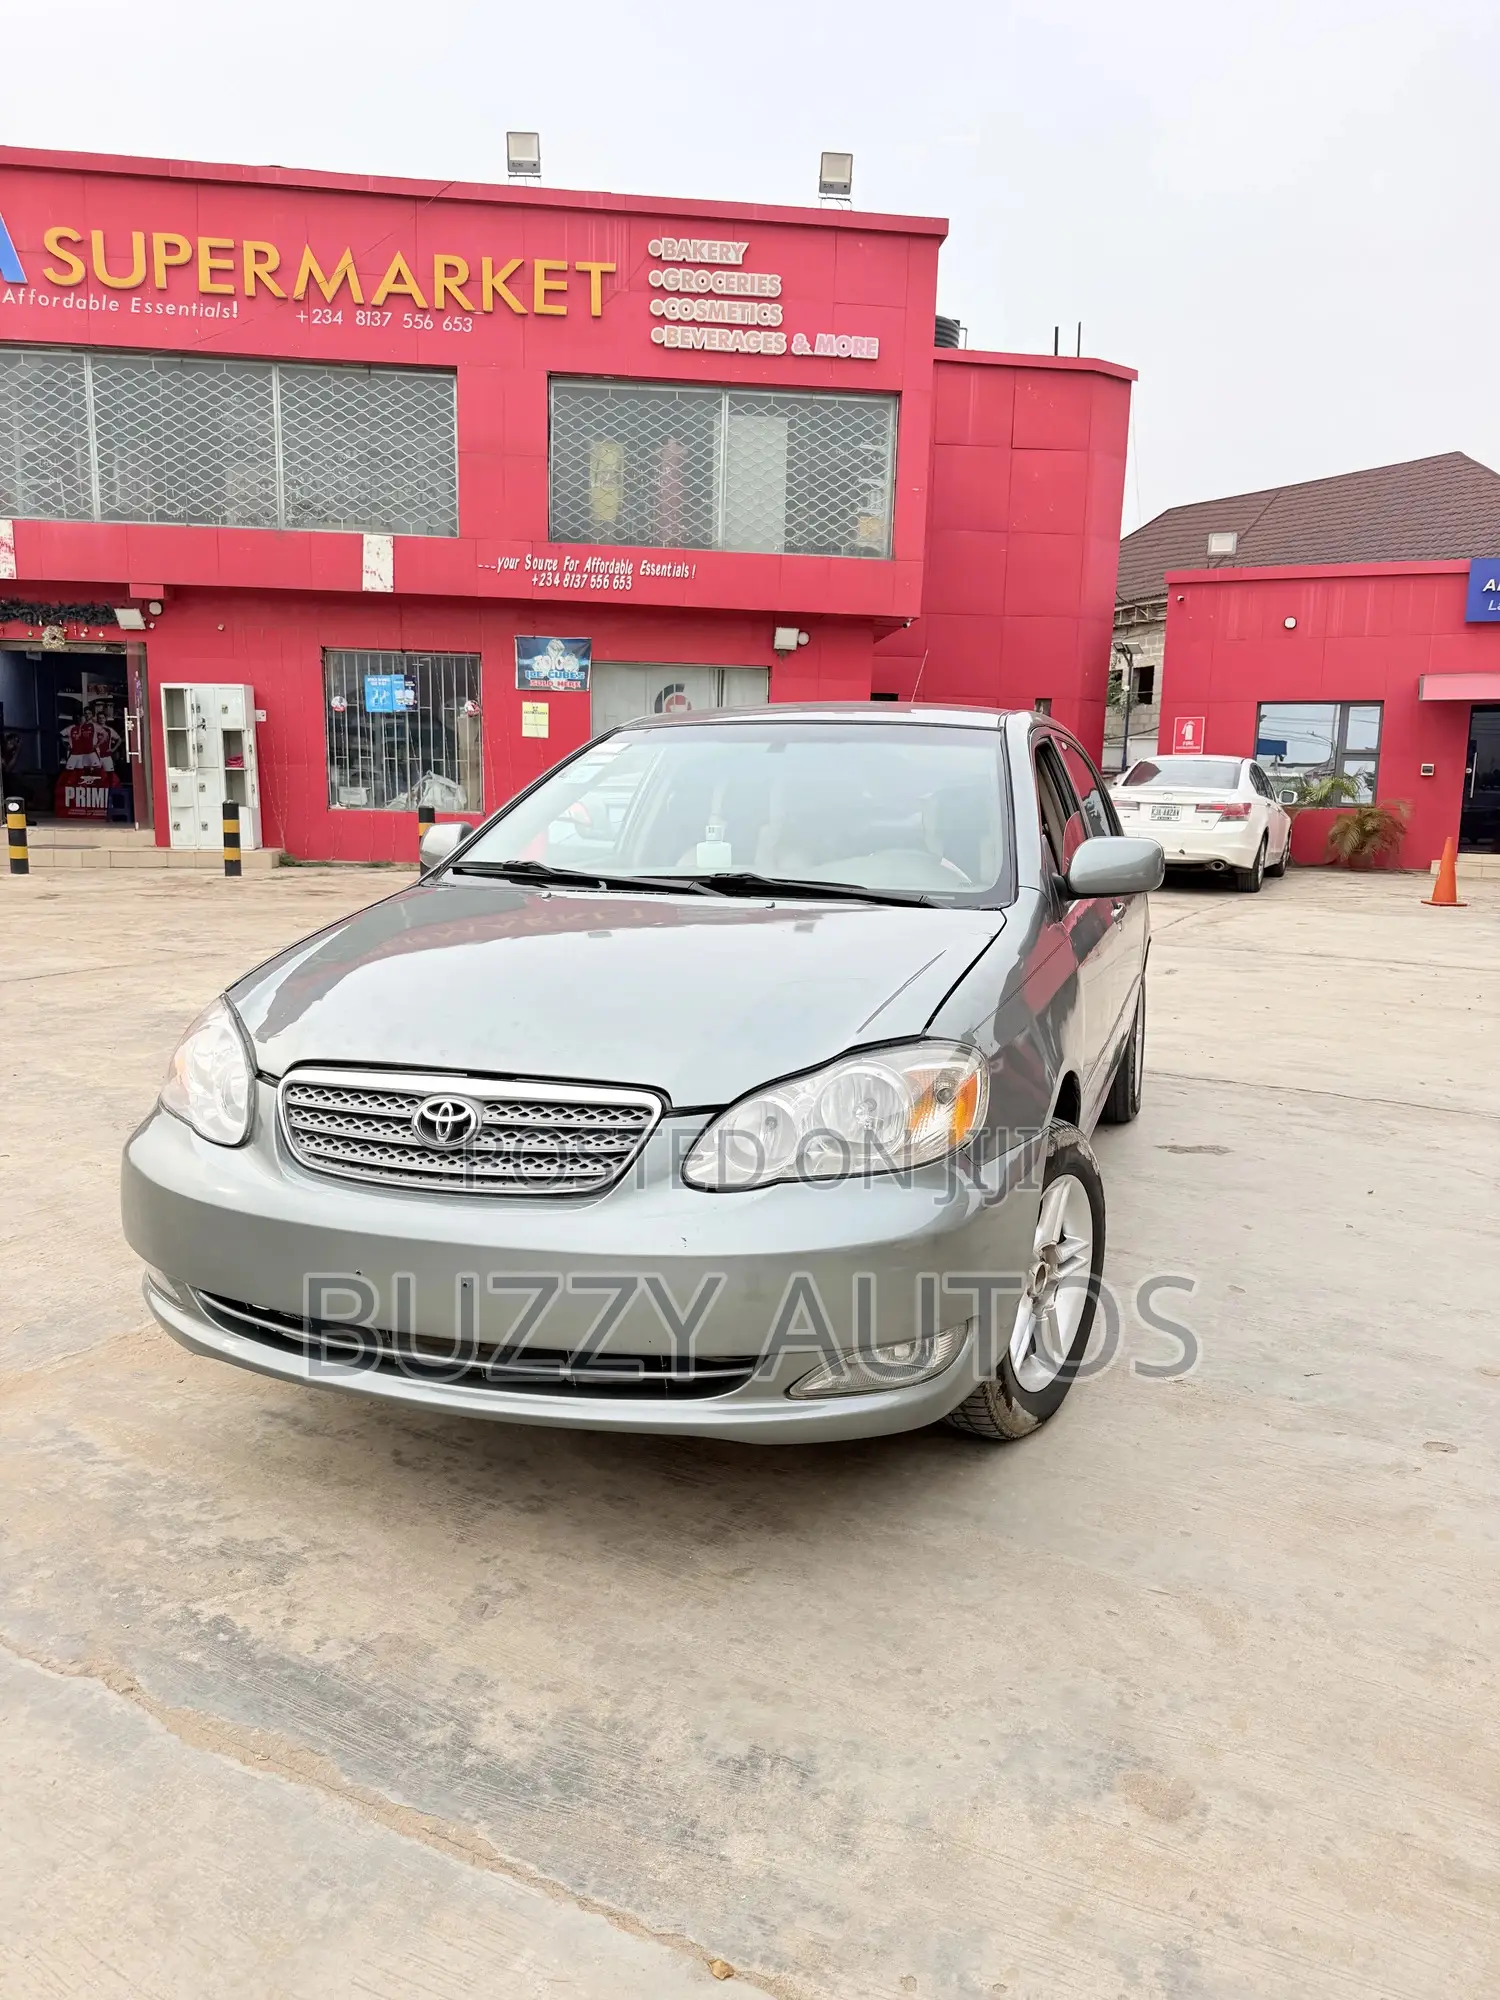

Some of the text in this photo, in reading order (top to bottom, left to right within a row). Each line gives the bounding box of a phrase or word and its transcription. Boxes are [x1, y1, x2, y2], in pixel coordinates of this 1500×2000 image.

[662, 238, 749, 265] BAKERY
[43, 226, 616, 318] SUPERMARKET
[662, 268, 782, 298] GROCERIES
[3, 288, 239, 319] Affordable Essentials!
[663, 299, 783, 327] COSMETICS
[296, 309, 473, 332] +234 8137 556 653
[664, 325, 879, 360] BEVERAGES & MORE
[524, 554, 558, 572] Source
[563, 556, 580, 571] For
[584, 556, 633, 576] Affordable
[531, 573, 632, 591] +234 8137 556 653
[524, 669, 585, 680] ICE CUBES
[557, 680, 582, 688] HERE
